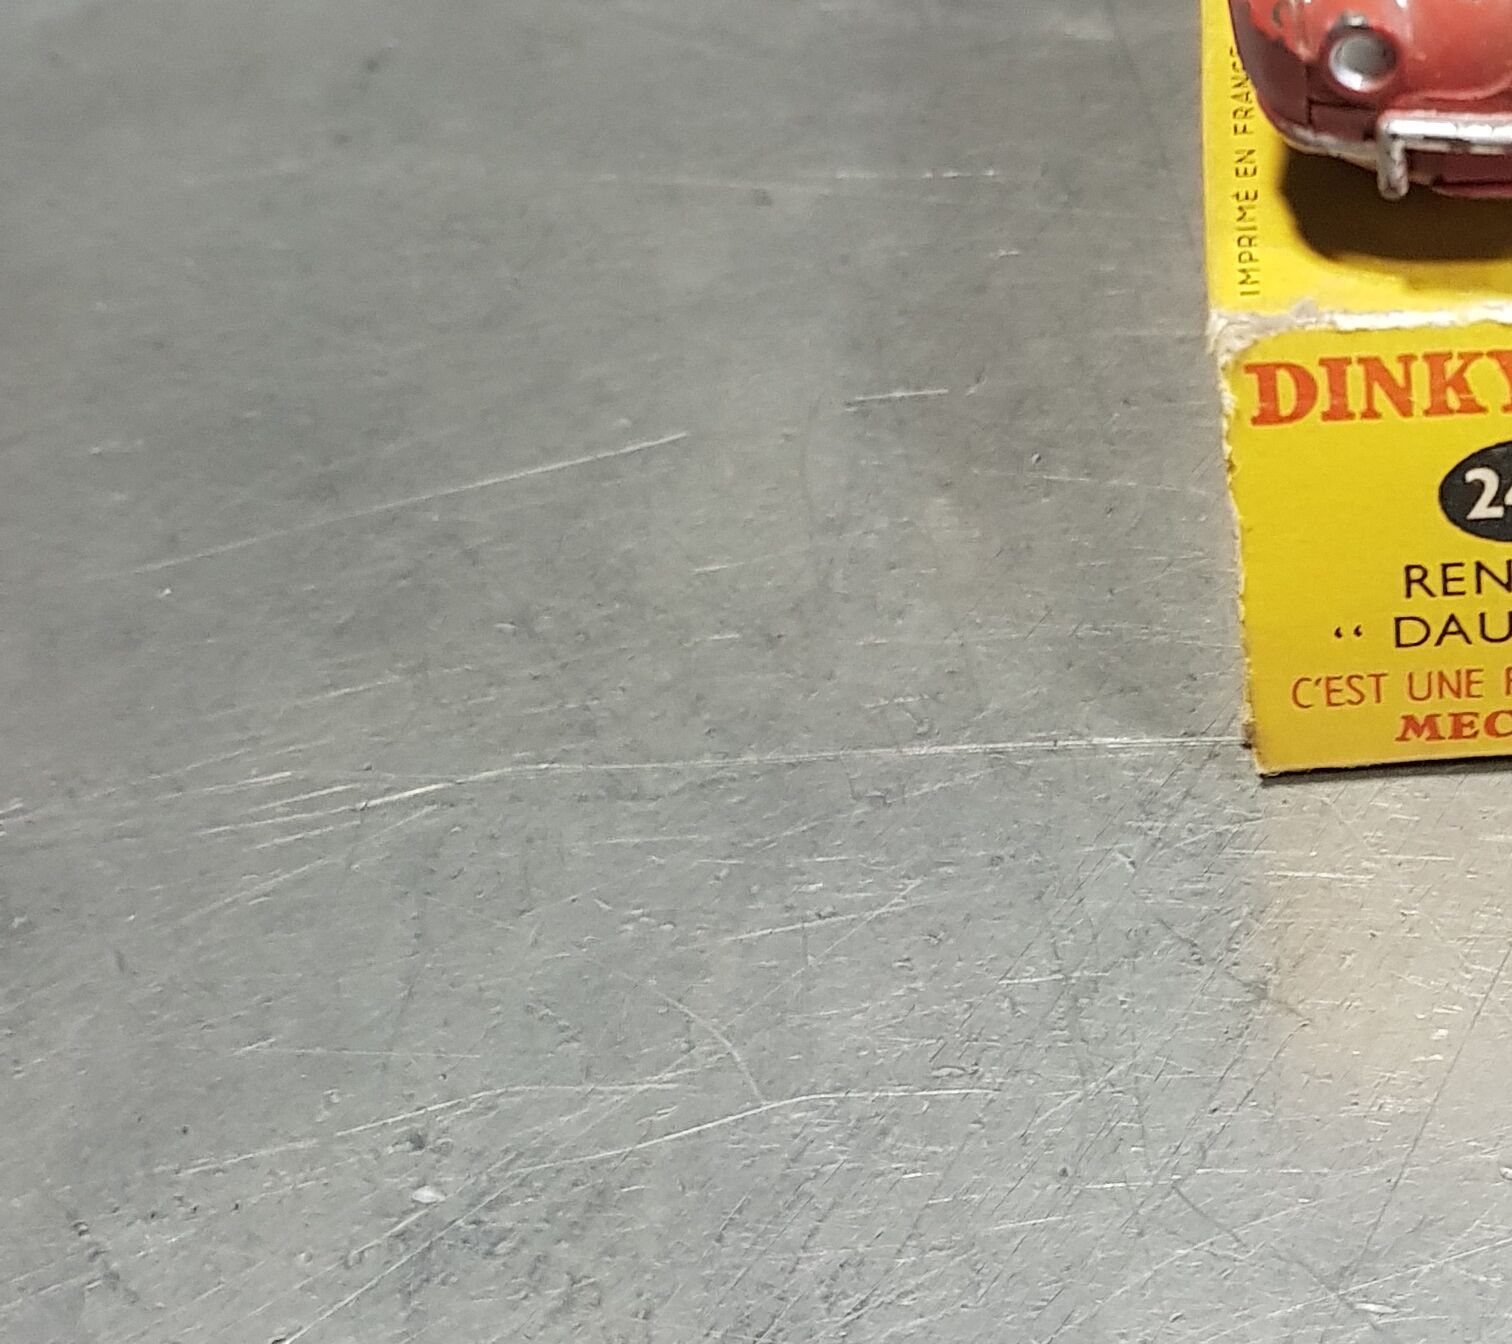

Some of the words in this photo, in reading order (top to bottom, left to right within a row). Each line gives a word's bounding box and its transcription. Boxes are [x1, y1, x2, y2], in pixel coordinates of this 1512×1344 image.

[1229, 47, 1255, 136] FRAN
[1234, 149, 1258, 178] EN
[1292, 673, 1389, 710] C'EST
[1407, 665, 1484, 701] UNE
